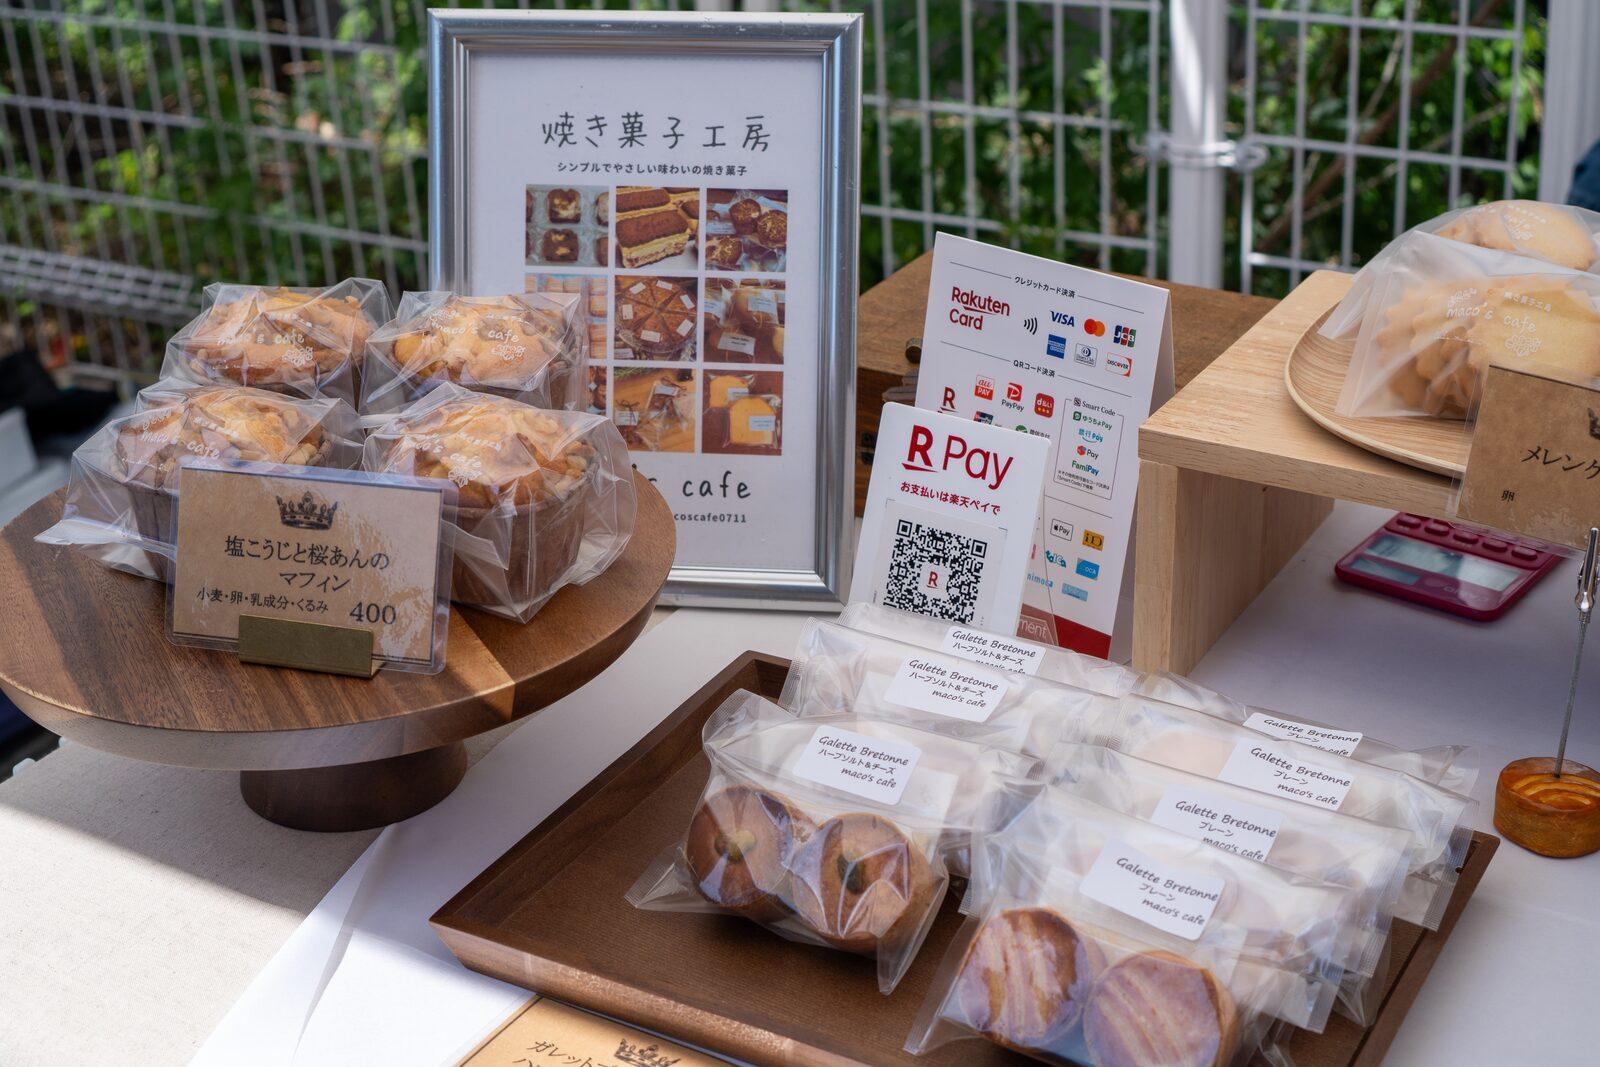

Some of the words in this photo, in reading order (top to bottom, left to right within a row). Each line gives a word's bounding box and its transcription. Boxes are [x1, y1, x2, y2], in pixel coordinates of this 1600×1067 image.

[541, 111, 771, 152] 焼き菓子工房
[557, 161, 748, 177] シンプルでやさしい味わいの焼き菓子
[1014, 276, 1076, 299] クレジットカード決済
[951, 286, 1010, 317] Rakuten
[949, 308, 984, 331] Card
[1050, 310, 1075, 328] VISA
[1446, 301, 1495, 321] maco's
[1503, 314, 1537, 333] cafe
[488, 329, 520, 344] cafe
[1013, 359, 1056, 378] QRコード決済
[977, 387, 991, 398] PAY
[1001, 399, 1025, 412] PayPay
[1081, 400, 1099, 413] Smart
[1100, 404, 1116, 417] Code
[907, 424, 934, 467] R
[943, 435, 1014, 490] Pay
[1087, 448, 1099, 460] Pay
[1071, 460, 1100, 476] FamiPay
[682, 470, 751, 499] cafe
[1501, 490, 1516, 502] 卵
[900, 481, 1001, 516] お支払いは楽天ペイで
[673, 512, 747, 524] coscafe0711
[1058, 525, 1070, 536] Pay
[224, 534, 390, 570] 塩こうじと桜あんの
[279, 570, 351, 593] マフィン
[197, 586, 329, 613] 小麦・卵・乳成分・くるみ
[349, 600, 397, 625] 400
[1020, 618, 1048, 640] ment
[952, 630, 988, 646] Galette
[990, 640, 1036, 658] Bretonne
[909, 659, 947, 677] Galette
[949, 671, 999, 691] Bretonne
[932, 690, 964, 703] maco's
[966, 699, 987, 708] cafe
[1264, 719, 1303, 733] Galette
[1307, 729, 1359, 743] Bretonne
[818, 736, 857, 753] Galette
[860, 746, 909, 766] Bretonne
[841, 767, 875, 783] maco's
[876, 777, 897, 789] cafe
[1250, 747, 1293, 771] Galette
[1296, 766, 1351, 787] Bretonne
[1277, 783, 1313, 799] maco's
[1315, 794, 1338, 806] cafe
[1175, 800, 1218, 820] Galette
[1221, 814, 1277, 838] Bretonne
[1202, 836, 1239, 853] maco's
[1240, 847, 1264, 860] cafe
[1116, 857, 1160, 884] Galette
[1163, 878, 1219, 902] Bretonne
[1142, 897, 1180, 918] maco's
[1181, 913, 1206, 926] cafe
[526, 1040, 618, 1067] ガレット
